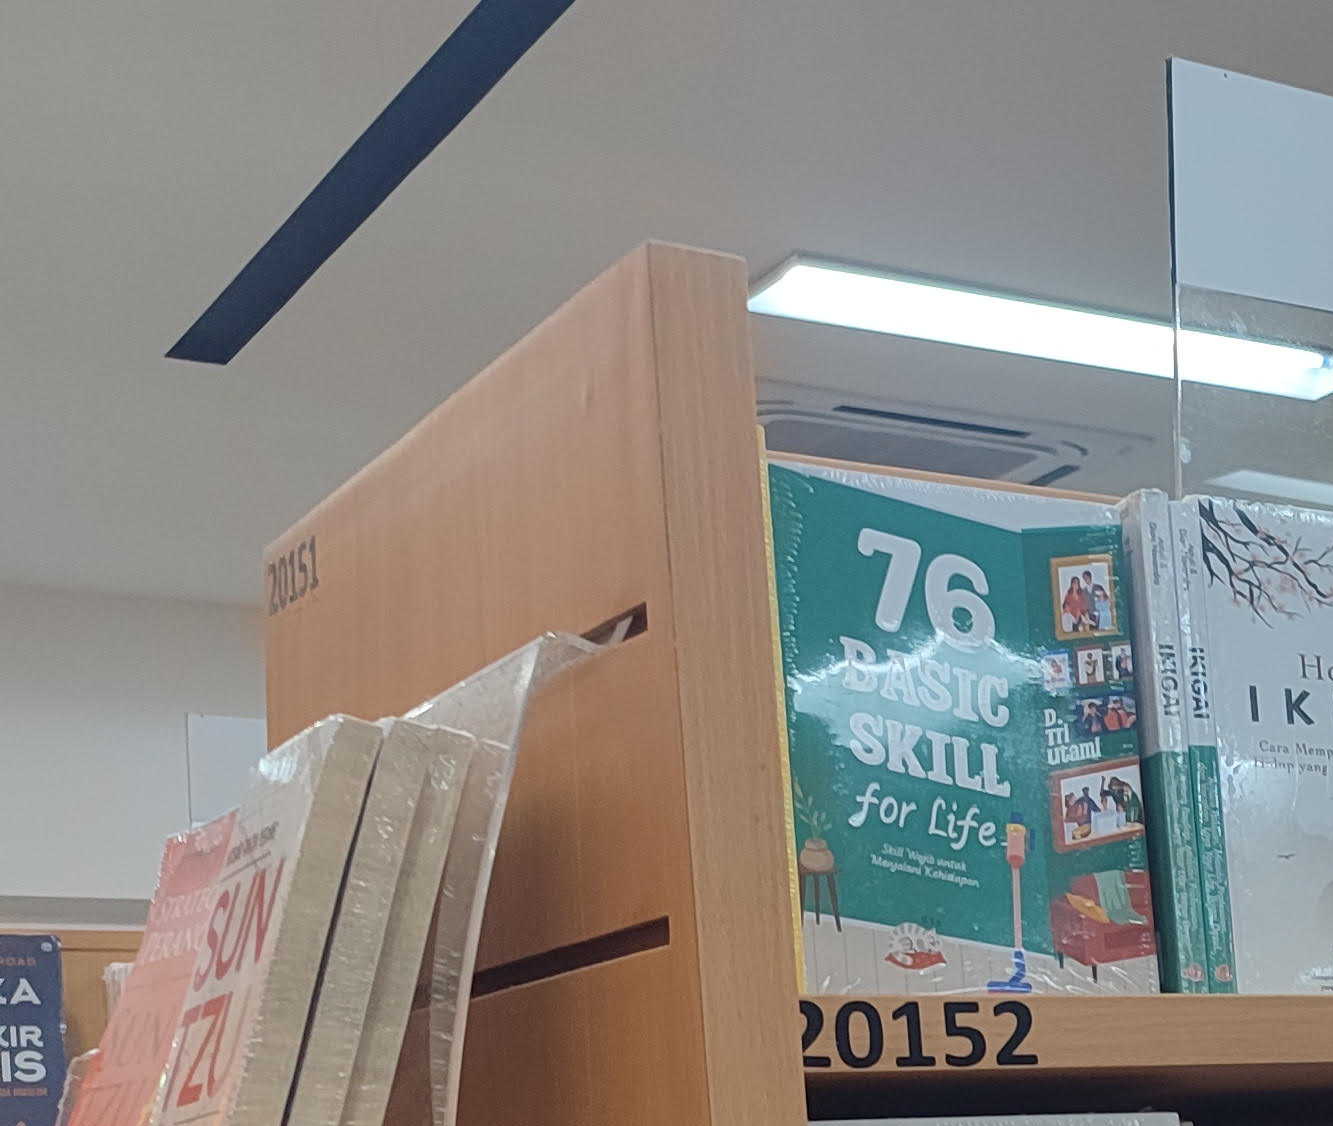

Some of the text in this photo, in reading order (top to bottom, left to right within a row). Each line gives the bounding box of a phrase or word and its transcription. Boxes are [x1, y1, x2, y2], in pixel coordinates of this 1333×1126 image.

[266, 535, 319, 617] 20151
[857, 527, 995, 653] 76
[839, 635, 1010, 727] BASIC
[850, 713, 1011, 797] SKILL
[1258, 740, 1290, 755] Cara
[1299, 763, 1328, 777] yang
[849, 783, 997, 850] for Life
[192, 856, 286, 994] SUN
[798, 1000, 1039, 1069] 20152
